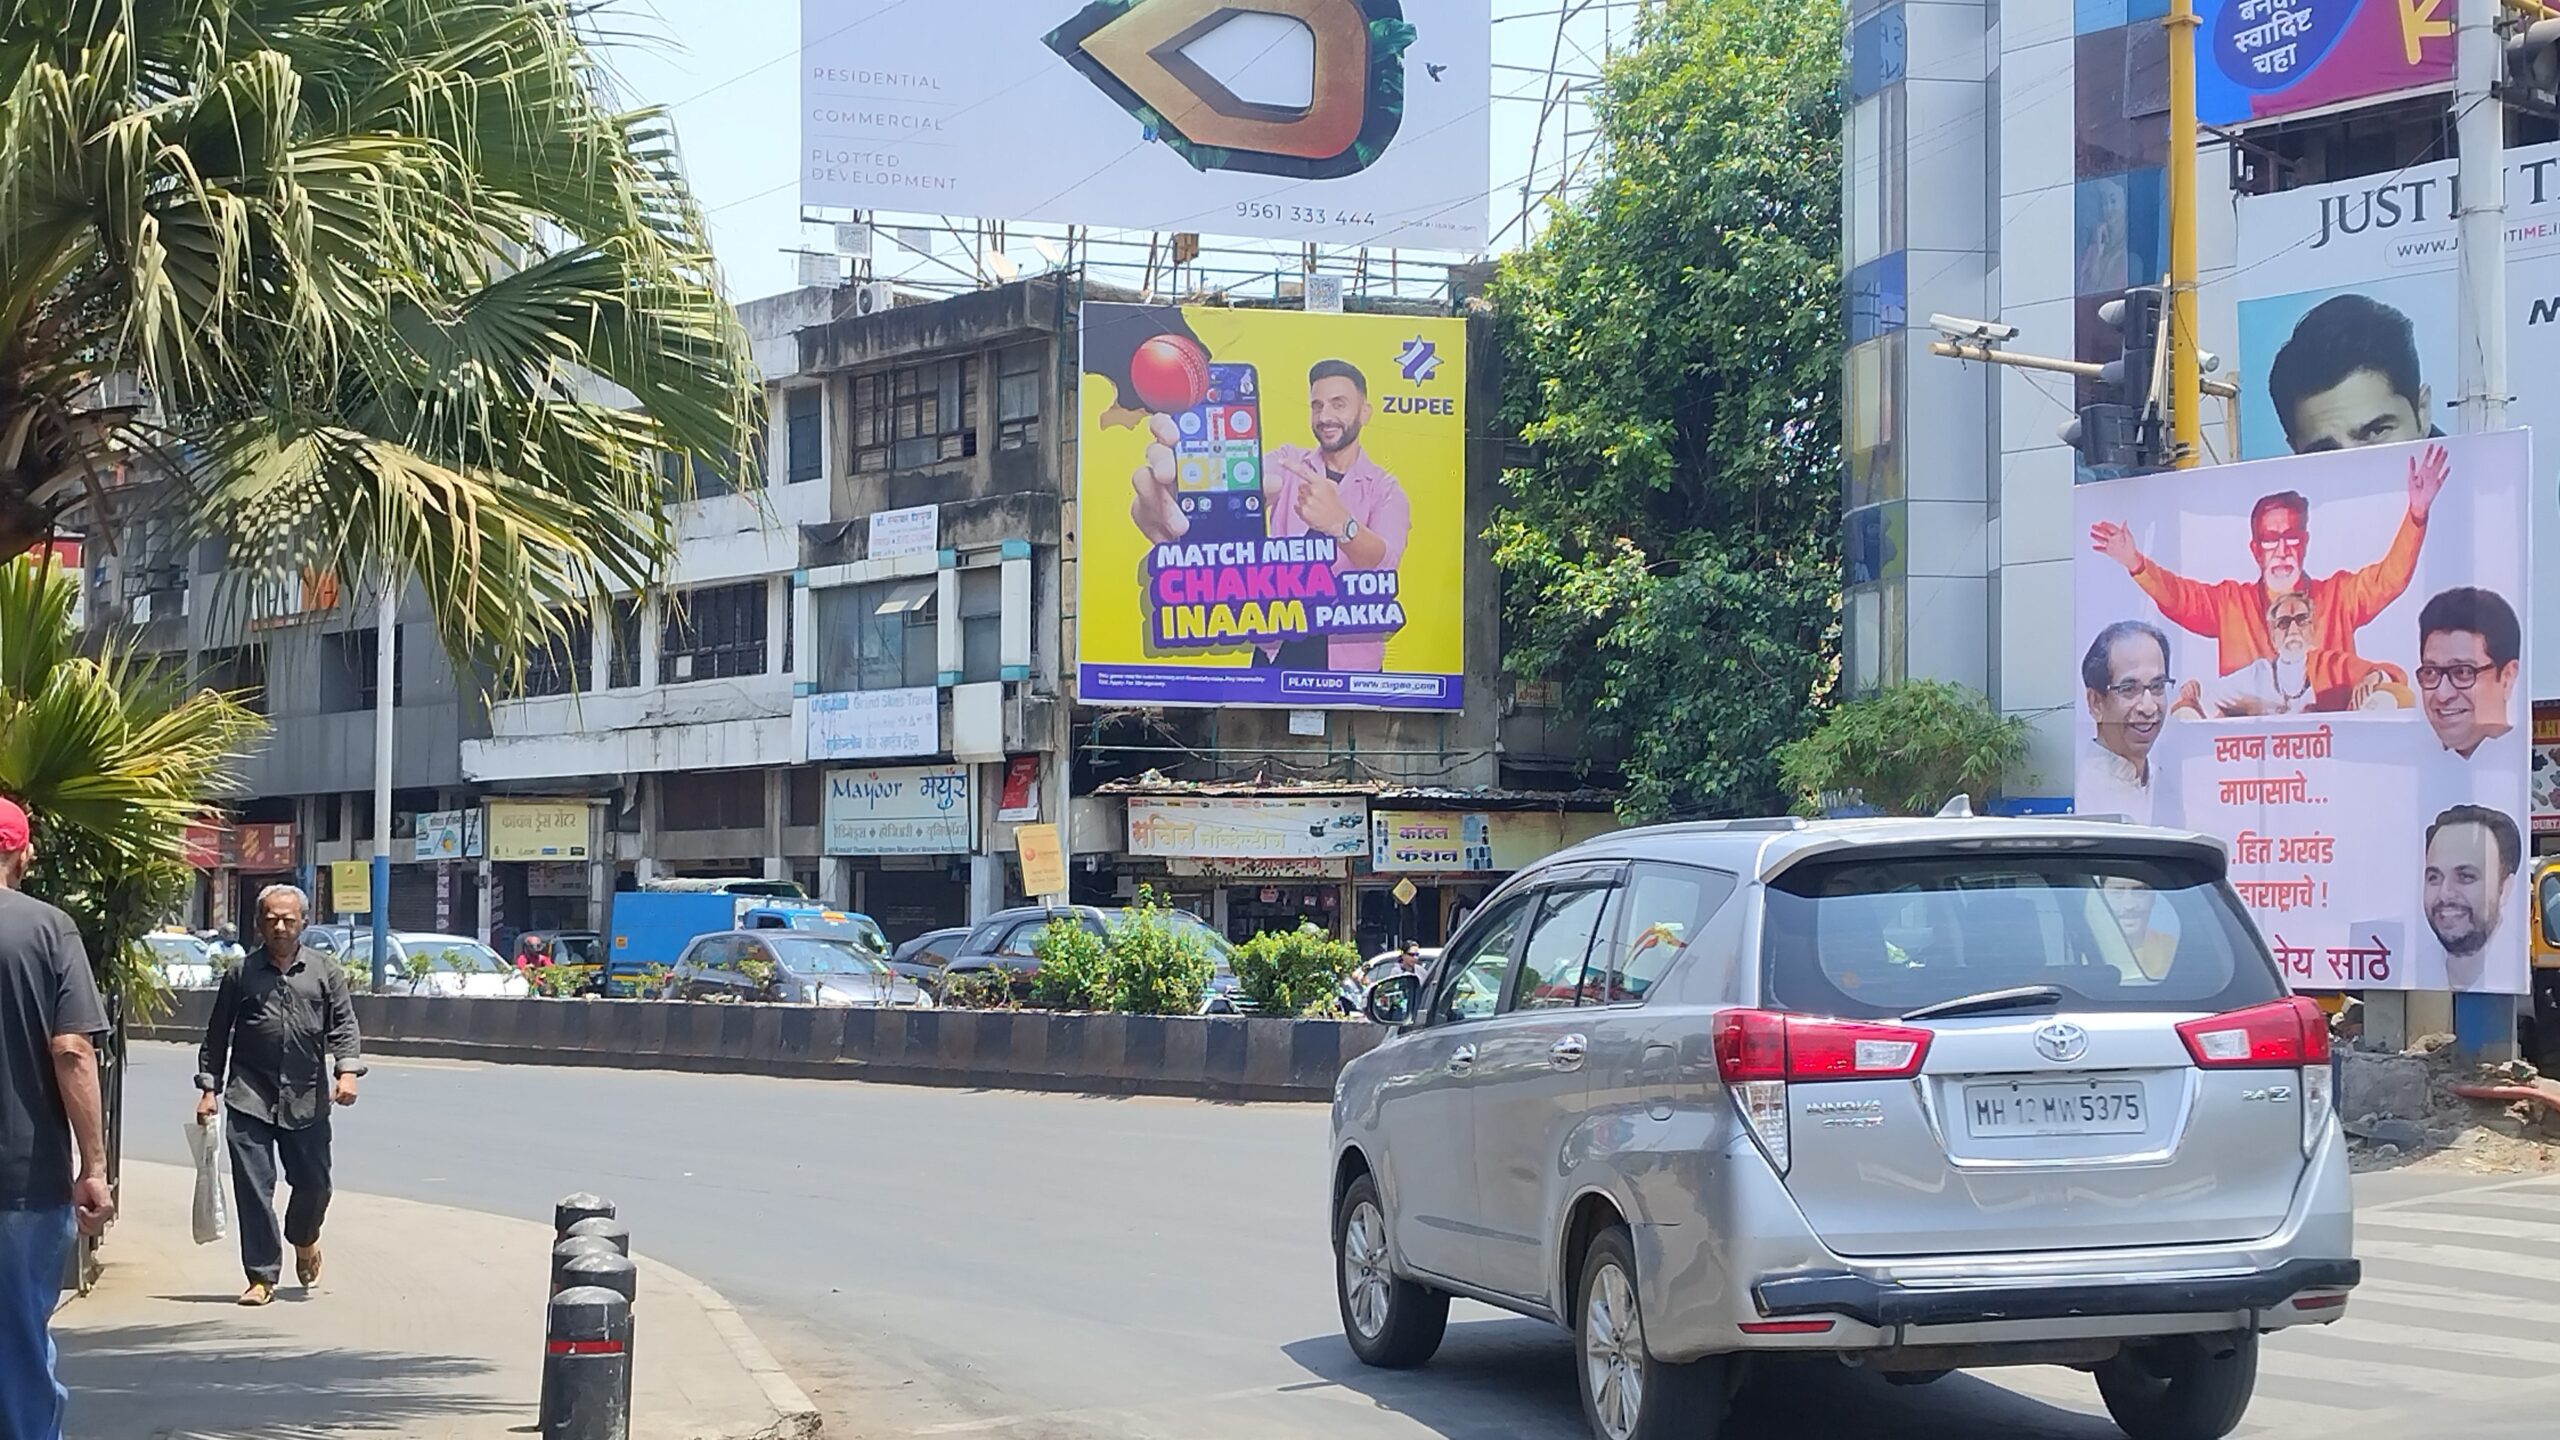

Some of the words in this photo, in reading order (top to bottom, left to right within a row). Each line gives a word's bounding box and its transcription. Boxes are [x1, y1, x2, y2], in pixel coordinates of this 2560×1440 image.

[2233, 8, 2313, 53] स्वादिष्ट
[2252, 43, 2297, 73] चहा
[814, 67, 941, 90] RESIDENTIAL
[813, 109, 944, 131] COMMERCIAL
[812, 149, 900, 168] PLOTTED
[812, 168, 957, 190] DEVELOPMENT
[1236, 201, 1282, 220] 9561
[1291, 206, 1326, 224] 333
[1335, 209, 1375, 227] 444
[2310, 178, 2437, 249] JUST
[2520, 158, 2560, 206] T
[1383, 396, 1454, 416] ZUPEE
[1157, 541, 1256, 569] MATCH
[1262, 538, 1335, 563] MEIN
[1158, 563, 1337, 604] CHAKKA
[1343, 572, 1396, 596] TOH
[1161, 600, 1308, 640] INAAM
[1316, 603, 1403, 628] PAKKA
[1288, 676, 1315, 688] PLAY
[1316, 677, 1344, 689] LUDO
[2214, 734, 2267, 762] स्वप्न
[2271, 725, 2333, 761] मराठी
[833, 777, 902, 810] Mayoor
[1399, 822, 1449, 840] कॉटन
[2278, 831, 2335, 865] अखंड
[2326, 935, 2391, 981] साठे
[1976, 1098, 2006, 1126] MH
[2015, 1098, 2037, 1124] 12
